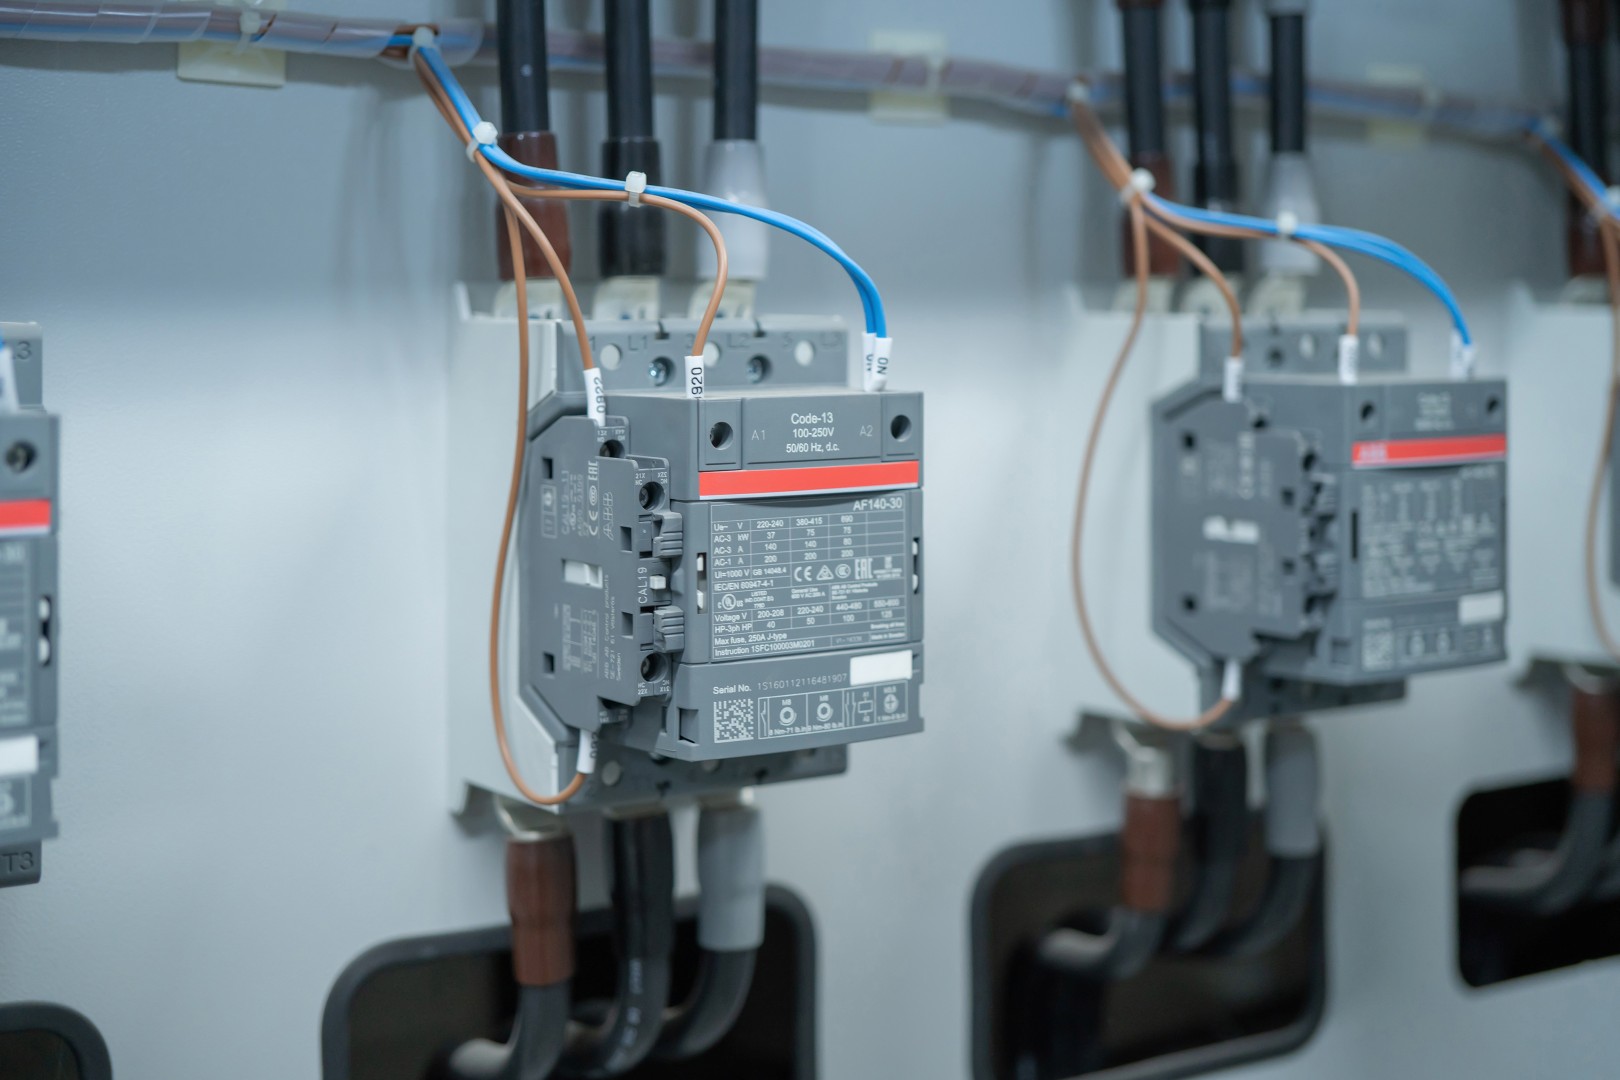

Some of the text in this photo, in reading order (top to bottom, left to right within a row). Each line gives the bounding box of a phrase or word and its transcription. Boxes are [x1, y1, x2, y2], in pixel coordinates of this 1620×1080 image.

[690, 367, 703, 399] 920
[791, 412, 833, 425] Code-13
[751, 430, 766, 441] A1
[792, 427, 835, 438] 100-250V
[859, 425, 873, 437] A2
[786, 441, 840, 454] 50/60 Hz, d.c.
[853, 497, 902, 511] AF140-30
[603, 491, 614, 541] ABB
[737, 522, 743, 530] V
[756, 520, 784, 529] 220-240
[796, 517, 823, 526] 380-415
[713, 534, 731, 543] AC-3
[737, 533, 749, 541] kW
[806, 528, 815, 536] 75
[713, 546, 732, 555] AC-3
[764, 543, 777, 551] 140
[804, 540, 817, 548] 140
[714, 558, 731, 567] AC-1
[737, 557, 744, 565] A
[764, 555, 777, 563] 200
[804, 552, 817, 560] 200
[752, 568, 763, 576] GB
[637, 566, 648, 604] CAL19
[714, 579, 774, 591] IEC/EN 60947-4-1
[714, 614, 740, 622] Voltage
[741, 612, 747, 620] V
[757, 609, 784, 619] 200-208
[797, 605, 824, 615] 220-240
[714, 625, 740, 634] HP-3ph
[741, 623, 752, 631] HP
[806, 617, 815, 625] 50
[714, 637, 729, 645] Max
[748, 634, 766, 642] 250A
[766, 633, 787, 641] J-type
[714, 646, 749, 657] Instruction
[713, 684, 736, 695] Serial
[738, 684, 752, 692] No.
[2, 851, 34, 872] T3
